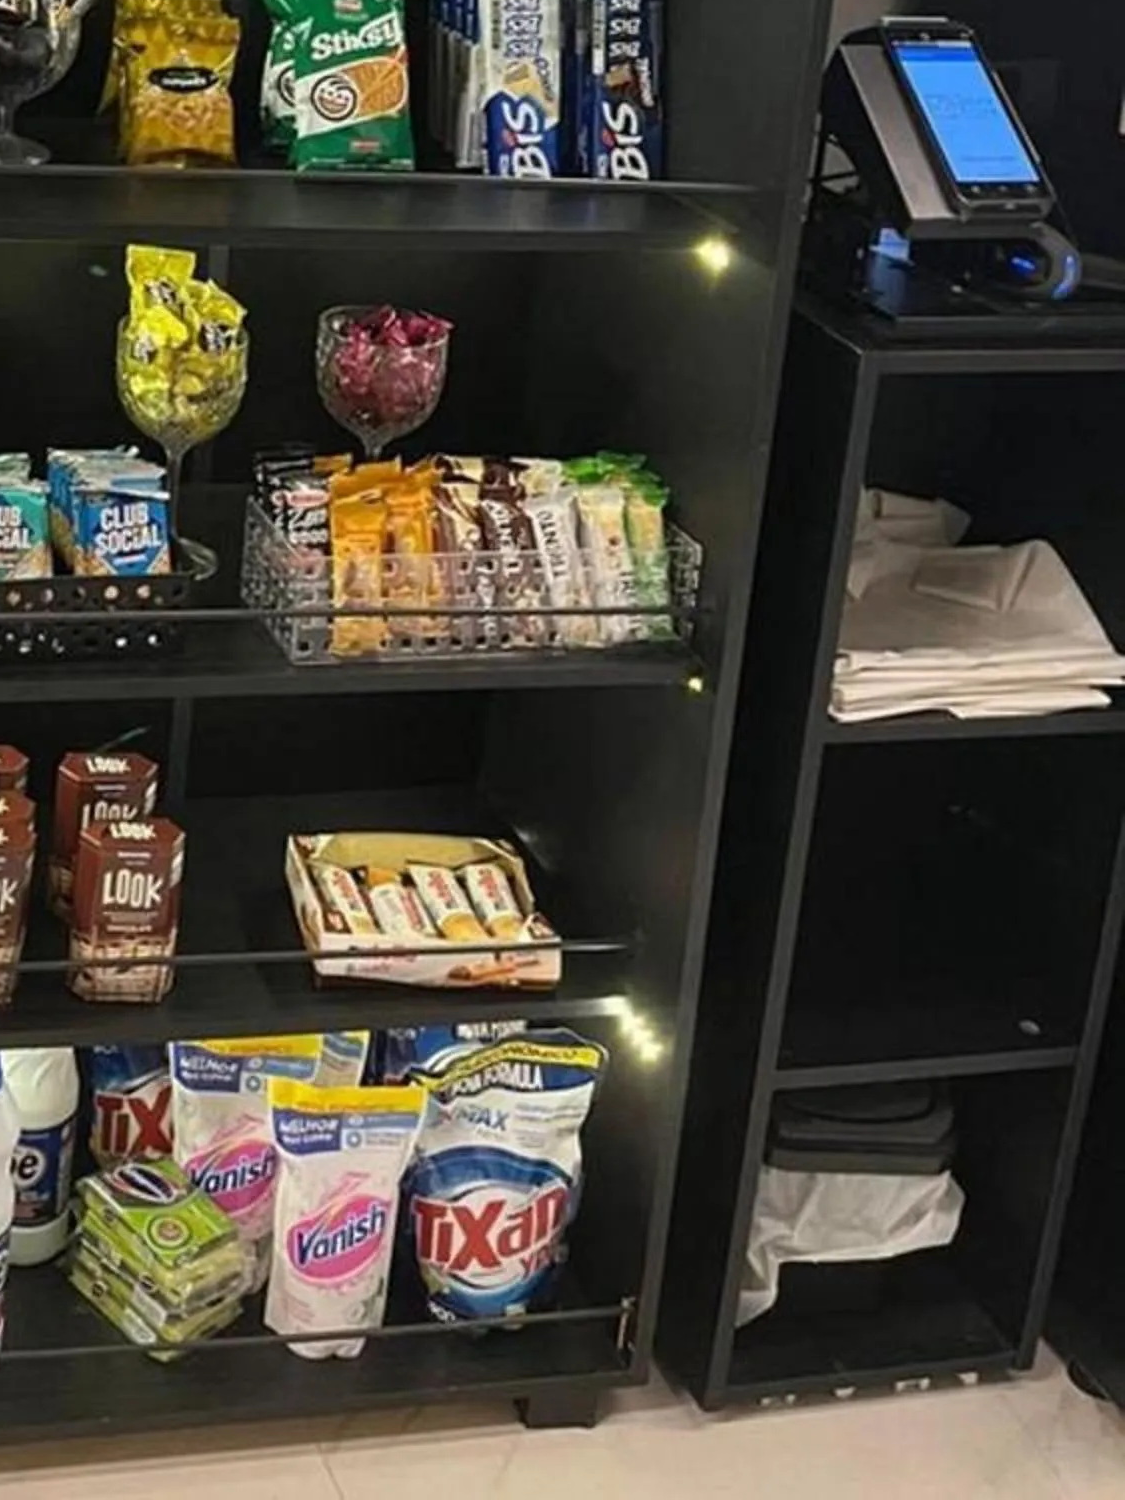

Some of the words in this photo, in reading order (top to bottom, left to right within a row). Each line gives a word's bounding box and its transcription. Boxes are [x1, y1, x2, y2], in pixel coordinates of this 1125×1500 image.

[501, 101, 551, 180] BIS
[602, 101, 650, 181] BIS
[99, 501, 149, 531] CLUB
[86, 757, 131, 774] LOOK
[108, 821, 157, 841] LOOK
[102, 868, 163, 910] LOOK
[188, 1148, 275, 1196] Vanish
[296, 1206, 387, 1265] Vanish
